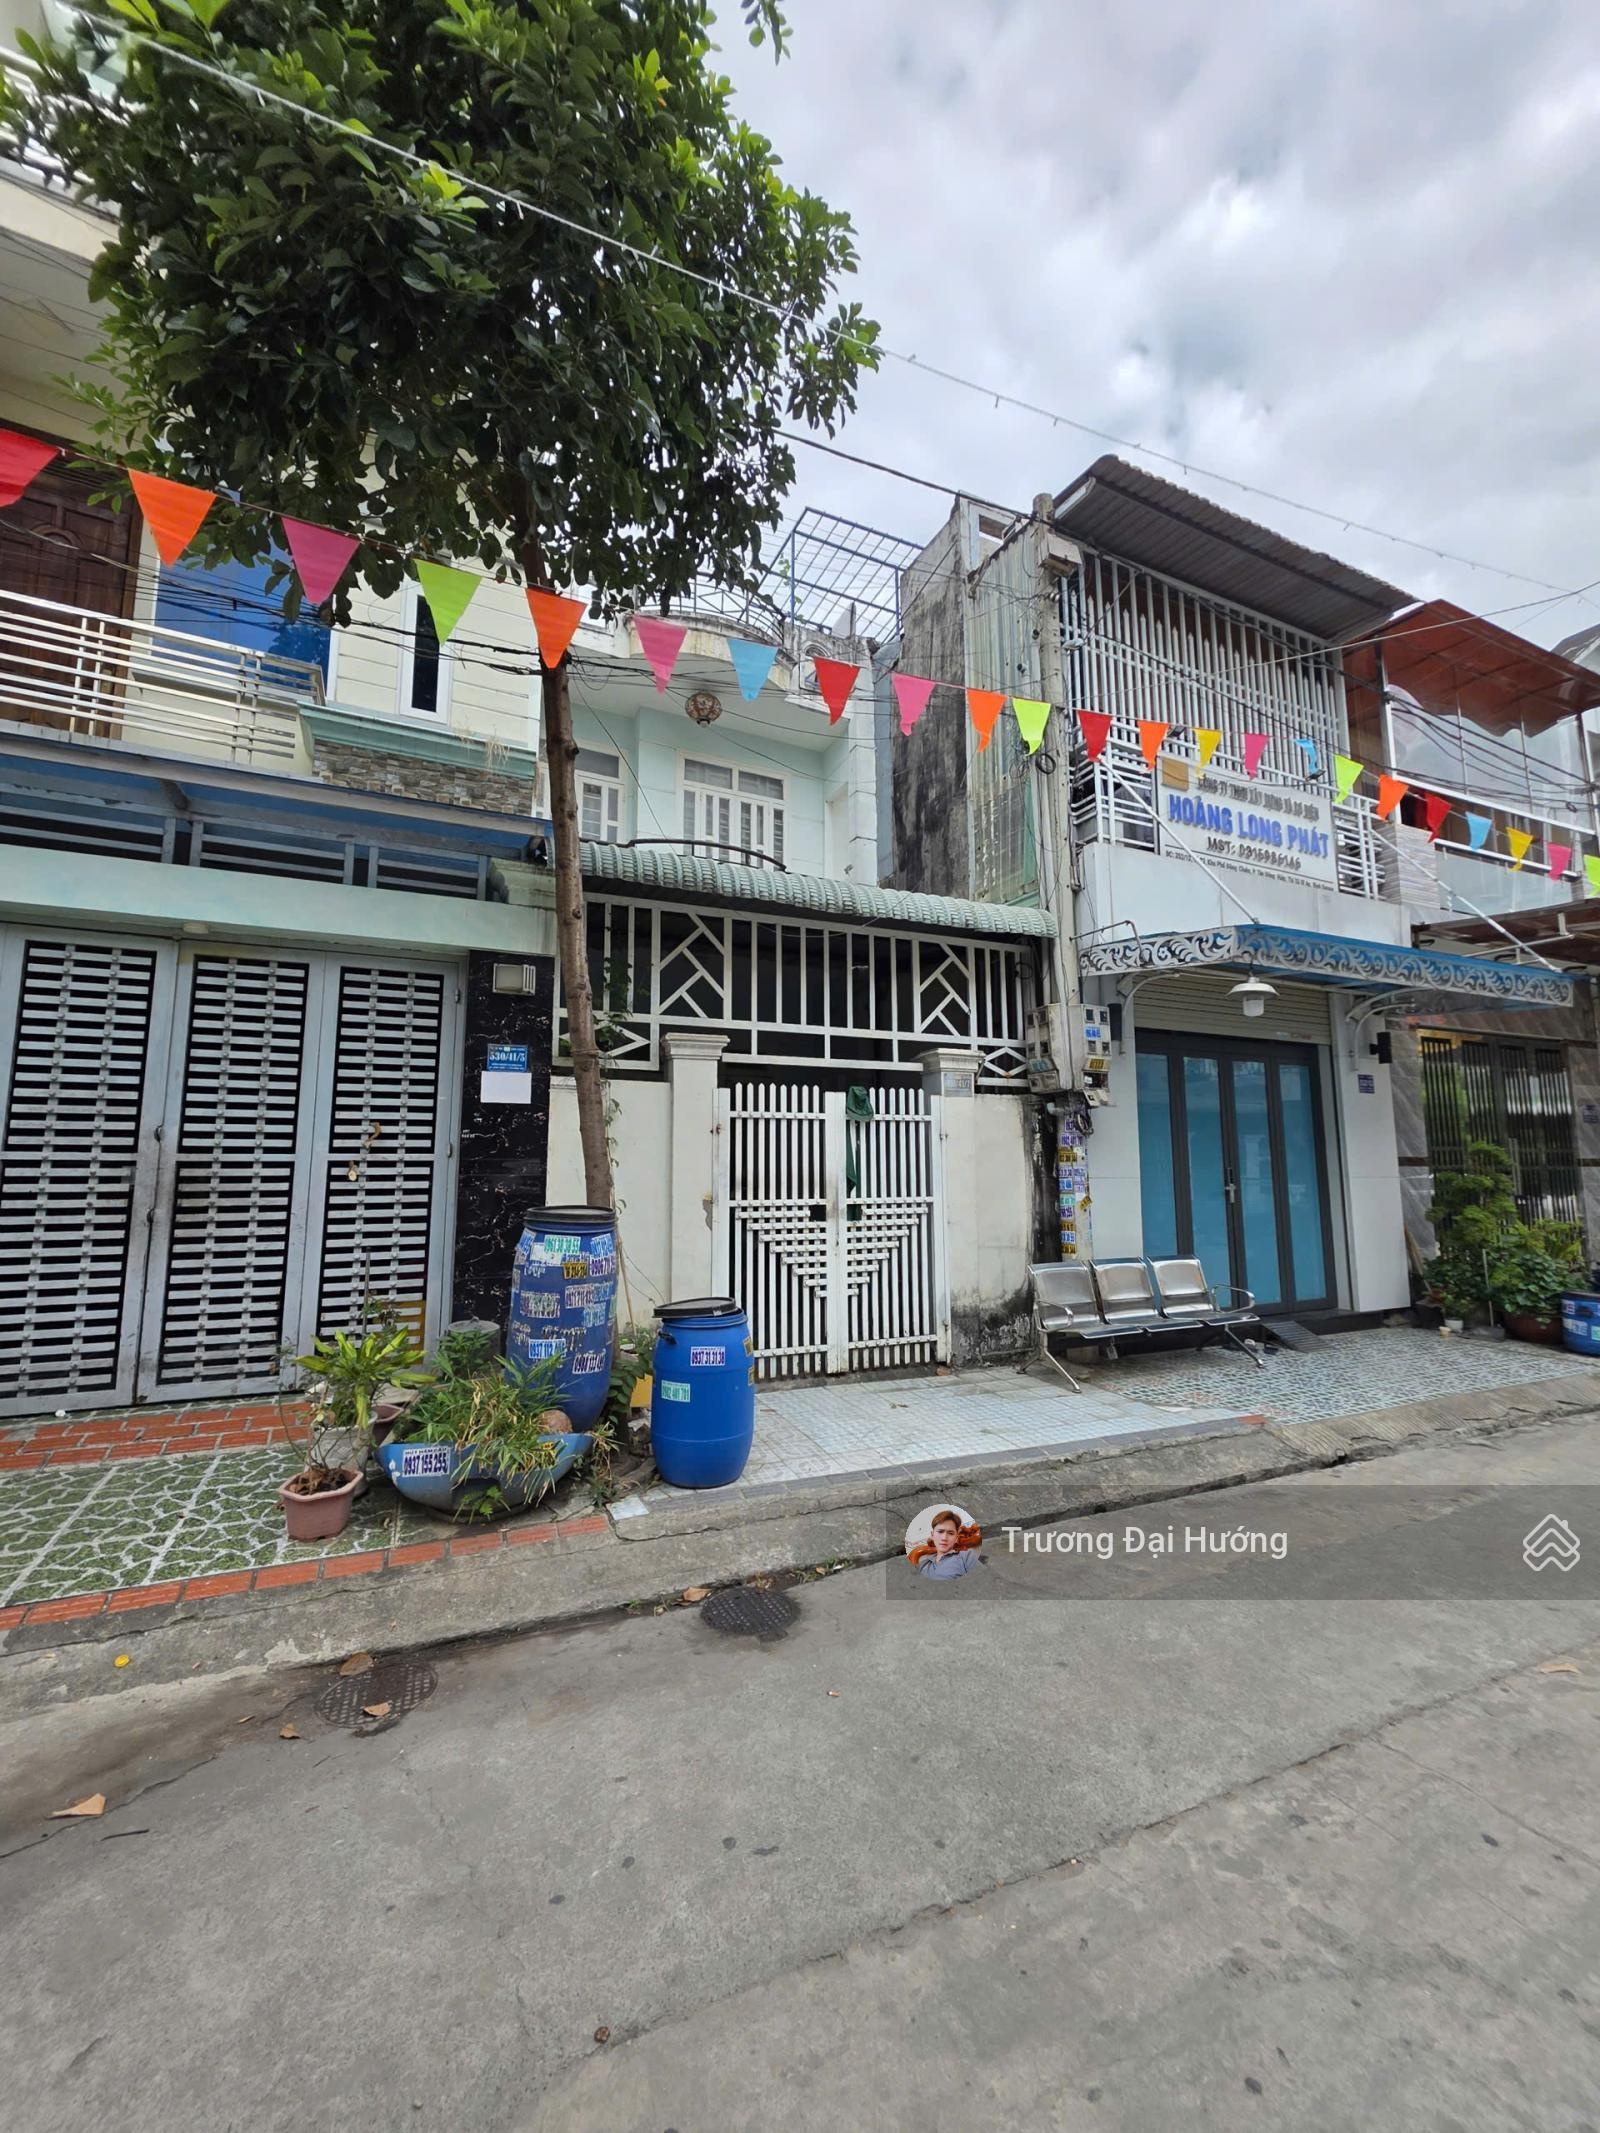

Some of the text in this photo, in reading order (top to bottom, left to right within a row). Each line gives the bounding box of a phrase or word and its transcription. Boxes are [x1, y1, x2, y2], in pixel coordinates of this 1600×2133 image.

[1238, 812, 1282, 847] LONG
[1286, 825, 1329, 859] PHÁT
[1207, 837, 1236, 855] MST:
[692, 1351, 704, 1364] 0937
[404, 1455, 420, 1475] 0937
[421, 1453, 433, 1474] 155
